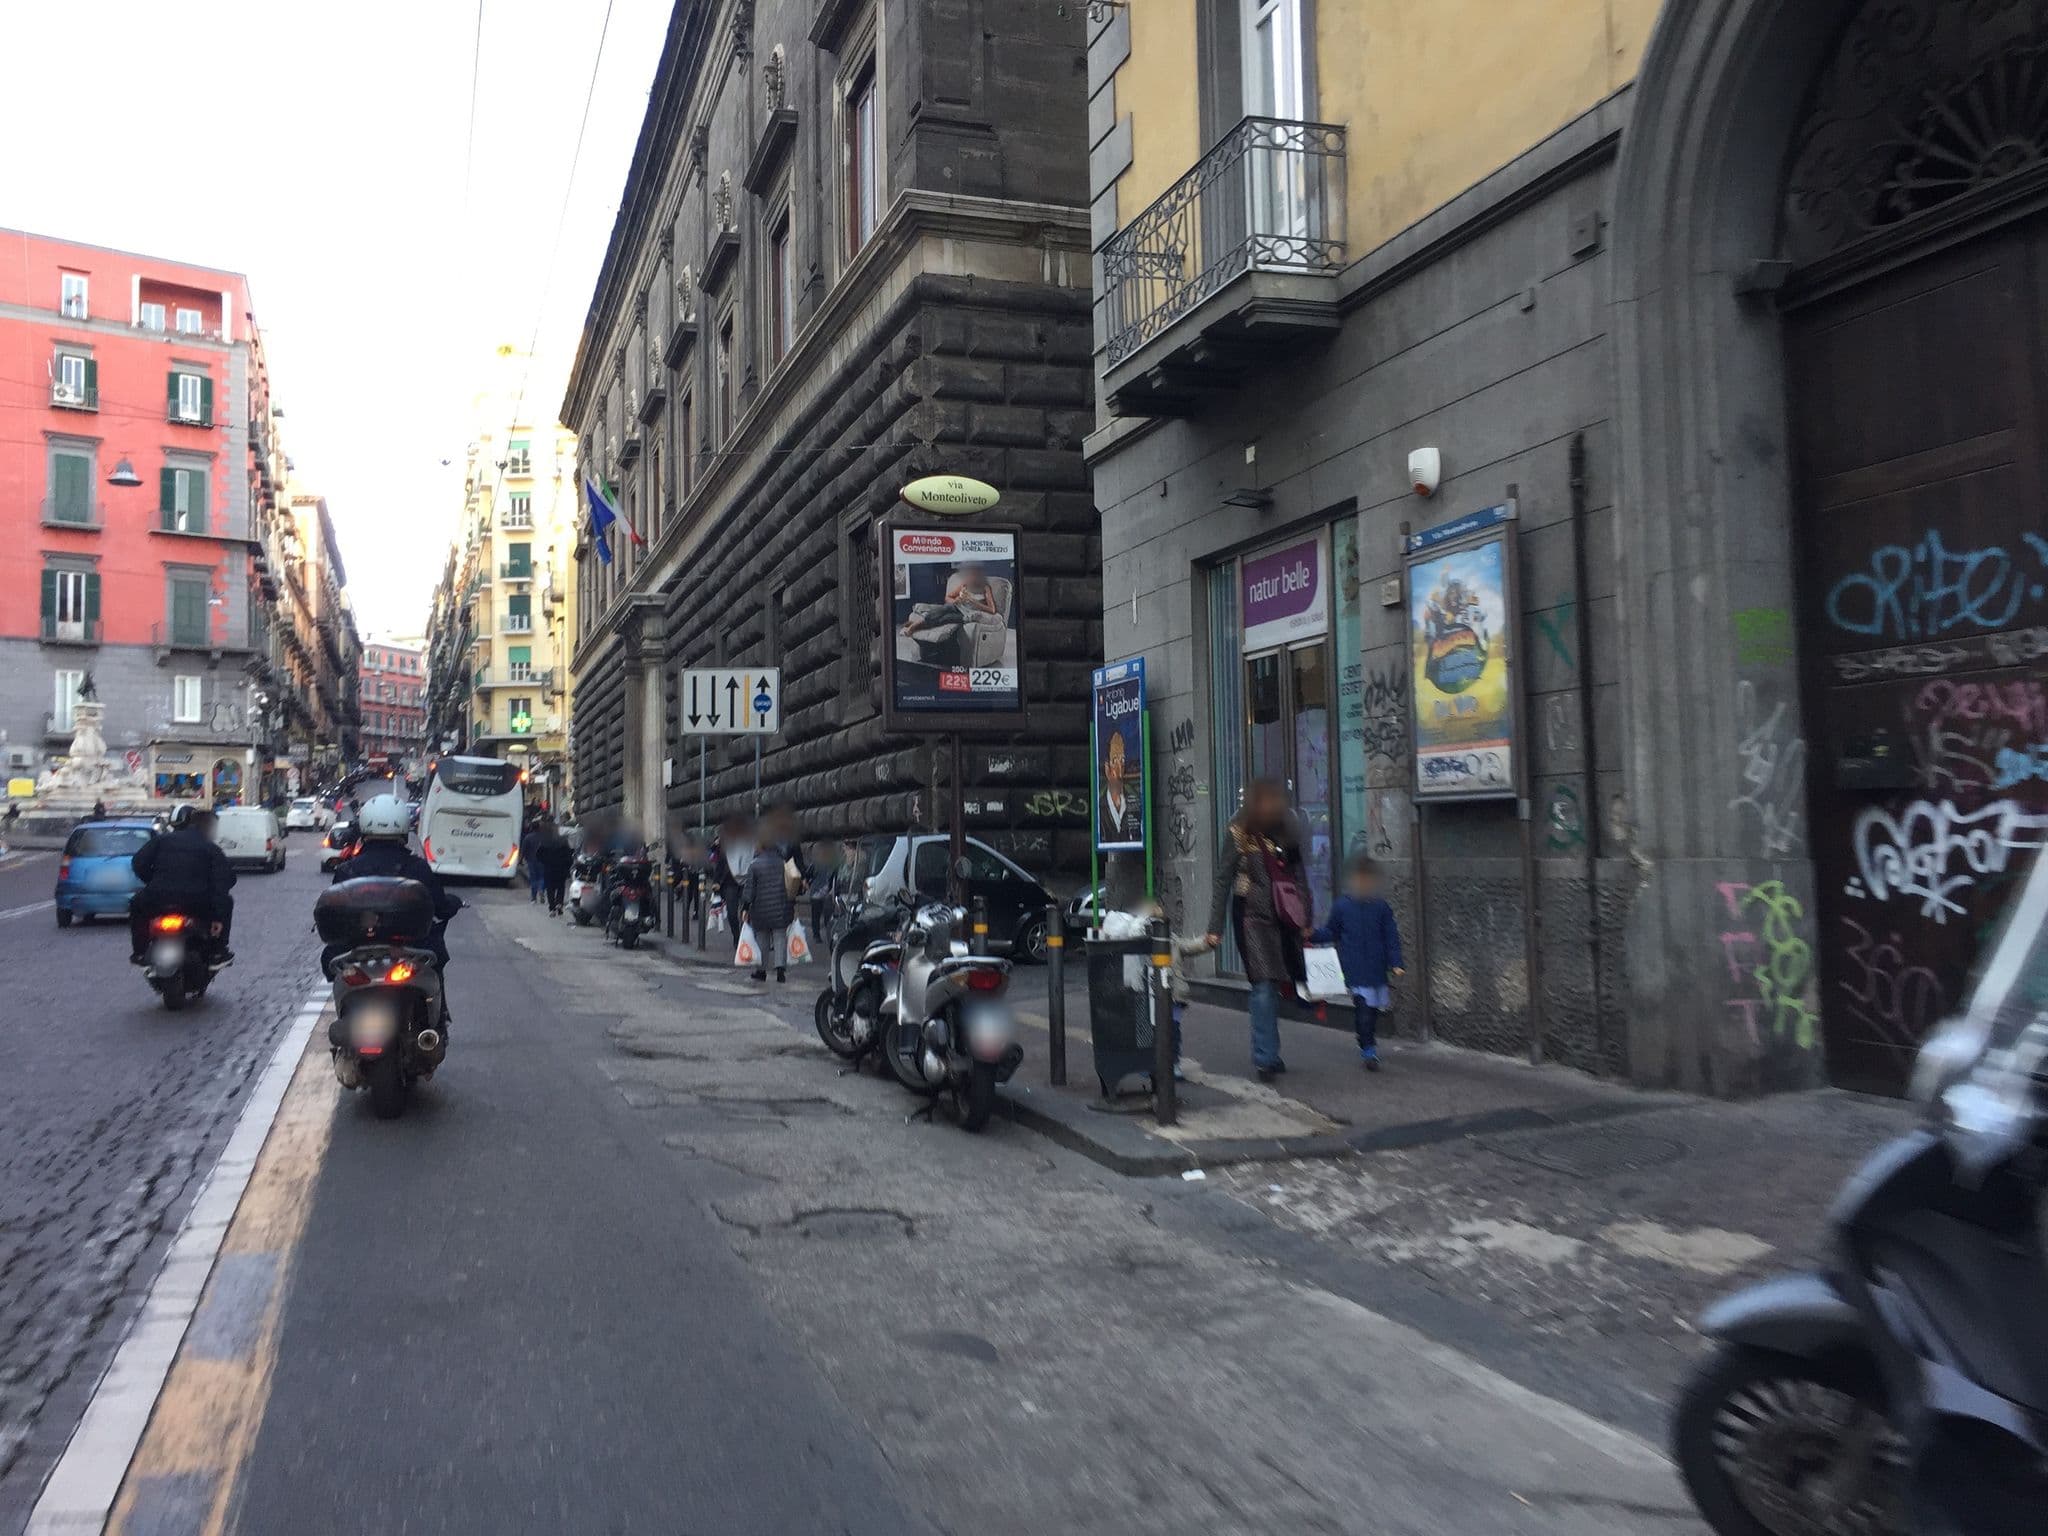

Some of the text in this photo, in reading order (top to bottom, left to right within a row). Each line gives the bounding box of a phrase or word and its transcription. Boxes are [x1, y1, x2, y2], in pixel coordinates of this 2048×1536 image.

[948, 480, 963, 489] via
[921, 491, 987, 505] Monteoliveto
[1249, 560, 1310, 603] natur belle
[1105, 697, 1139, 719] Ligabue
